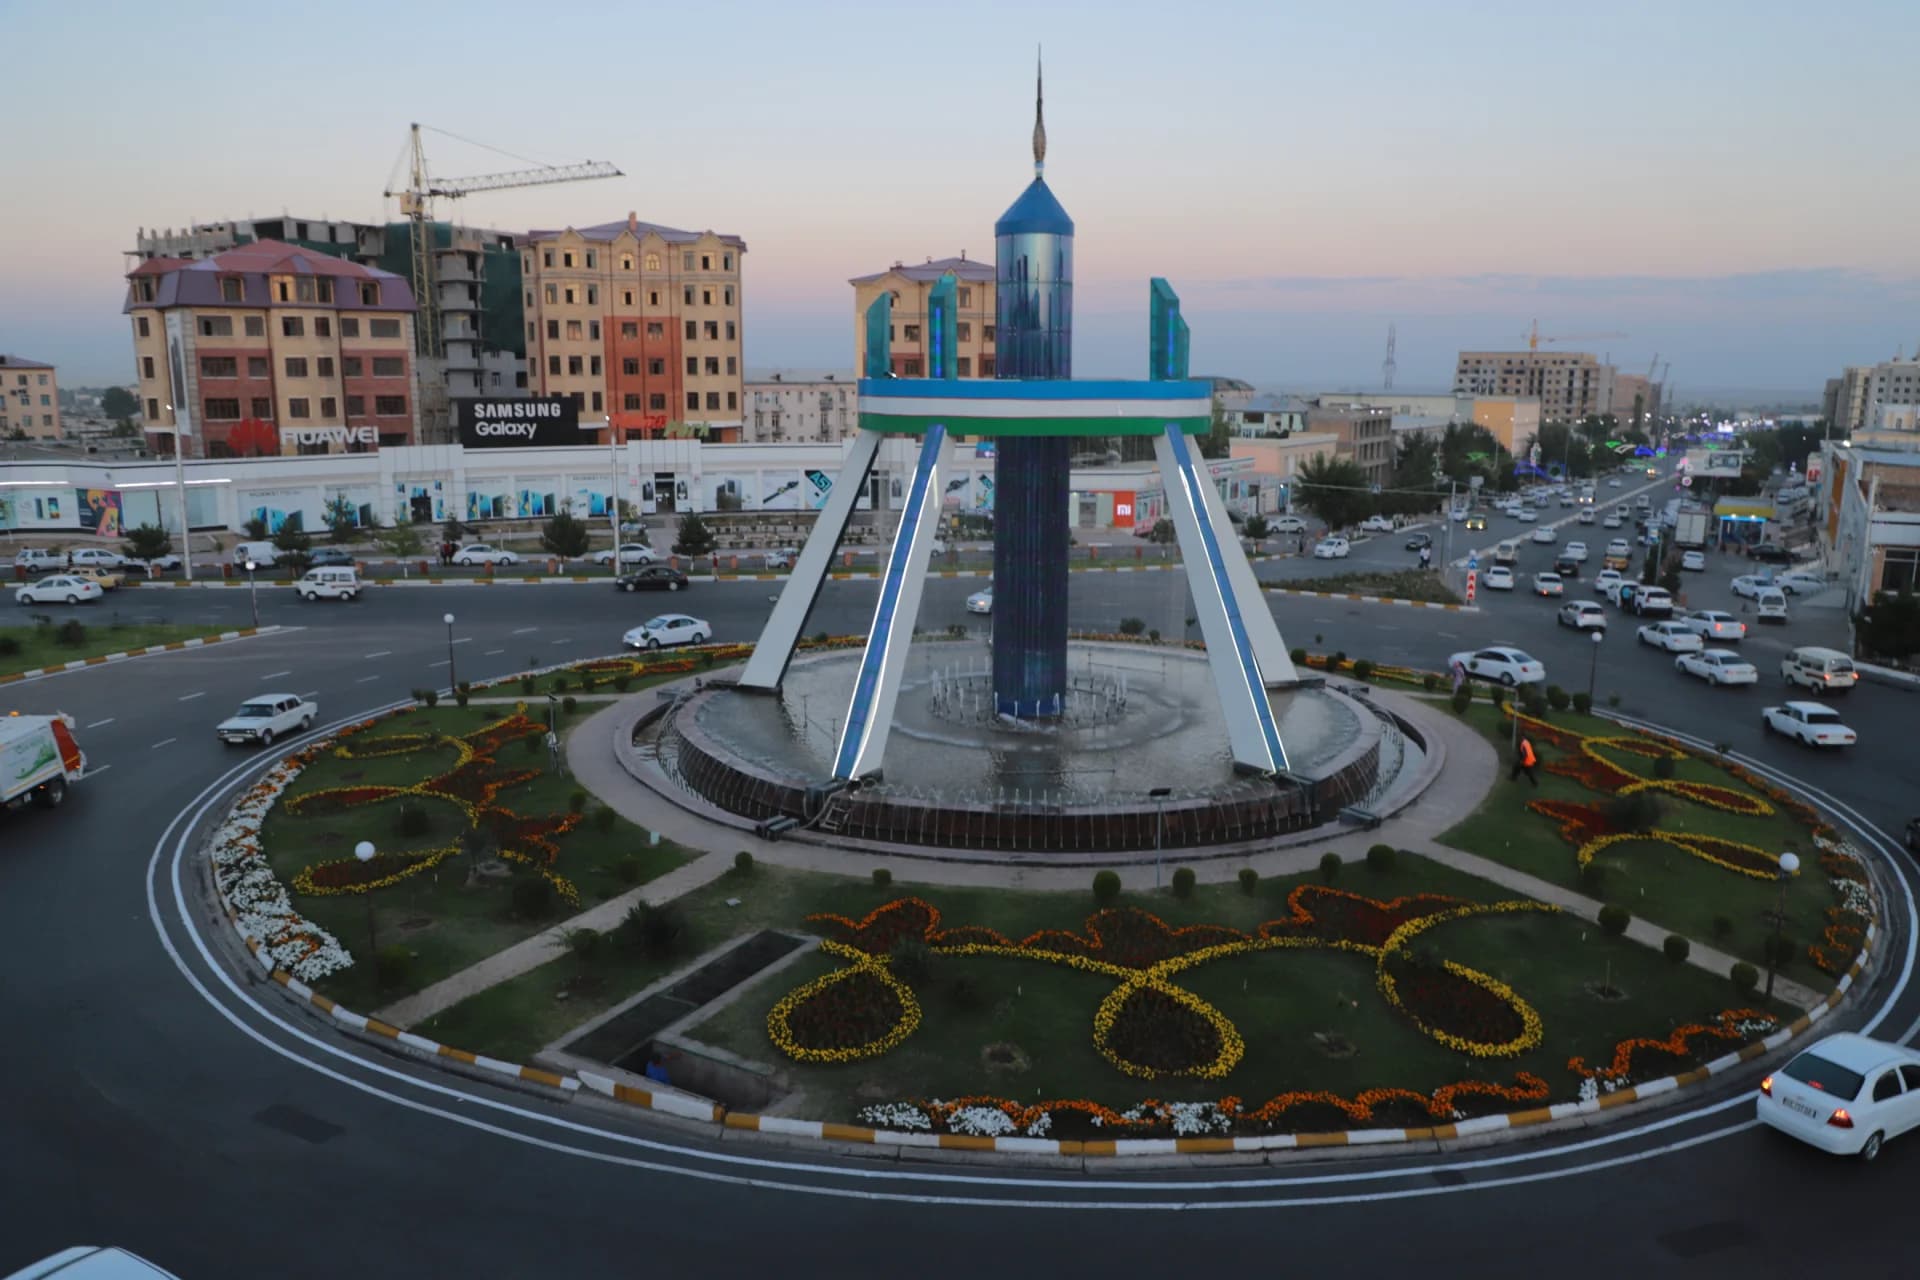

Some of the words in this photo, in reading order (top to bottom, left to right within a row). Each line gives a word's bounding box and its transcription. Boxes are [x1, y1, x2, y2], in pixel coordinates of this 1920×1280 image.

[474, 403, 561, 418] SAMSUNG
[281, 426, 379, 445] HUAWEI
[475, 421, 537, 439] Galaxy
